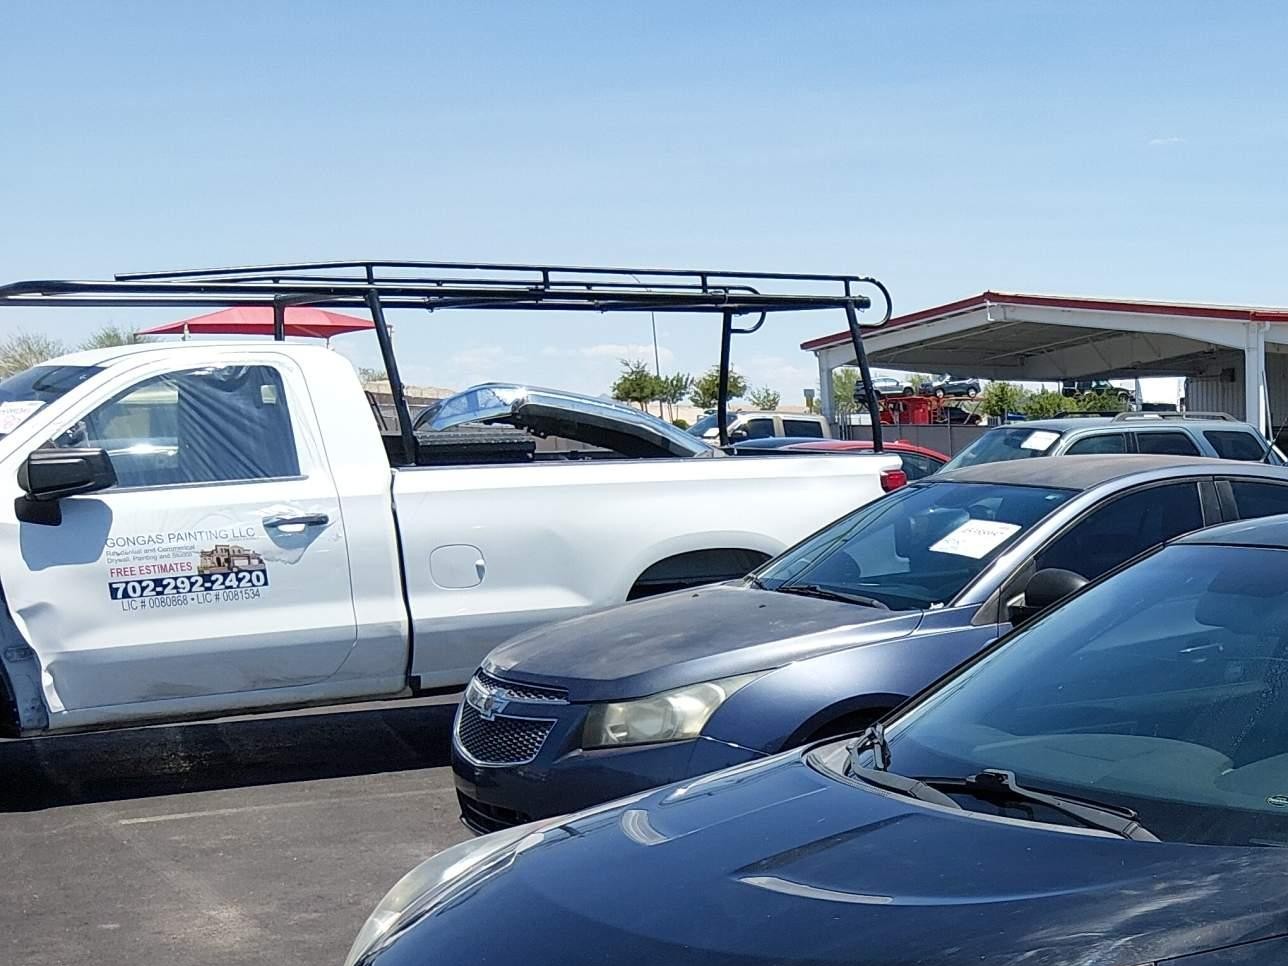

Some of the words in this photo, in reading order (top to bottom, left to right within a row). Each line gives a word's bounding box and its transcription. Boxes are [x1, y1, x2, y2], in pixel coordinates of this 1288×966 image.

[105, 534, 164, 548] GONGAS
[167, 529, 228, 543] PAINTING
[231, 527, 256, 538] LLC
[110, 567, 137, 578] FREE
[138, 562, 193, 575] ESTIMATES
[111, 571, 266, 599] 702-292-2420
[121, 600, 138, 612] LIC
[140, 599, 146, 610] #
[149, 595, 189, 609] 0080868
[196, 592, 213, 604] LIC
[215, 591, 221, 603] #
[222, 588, 261, 602] 0081534
